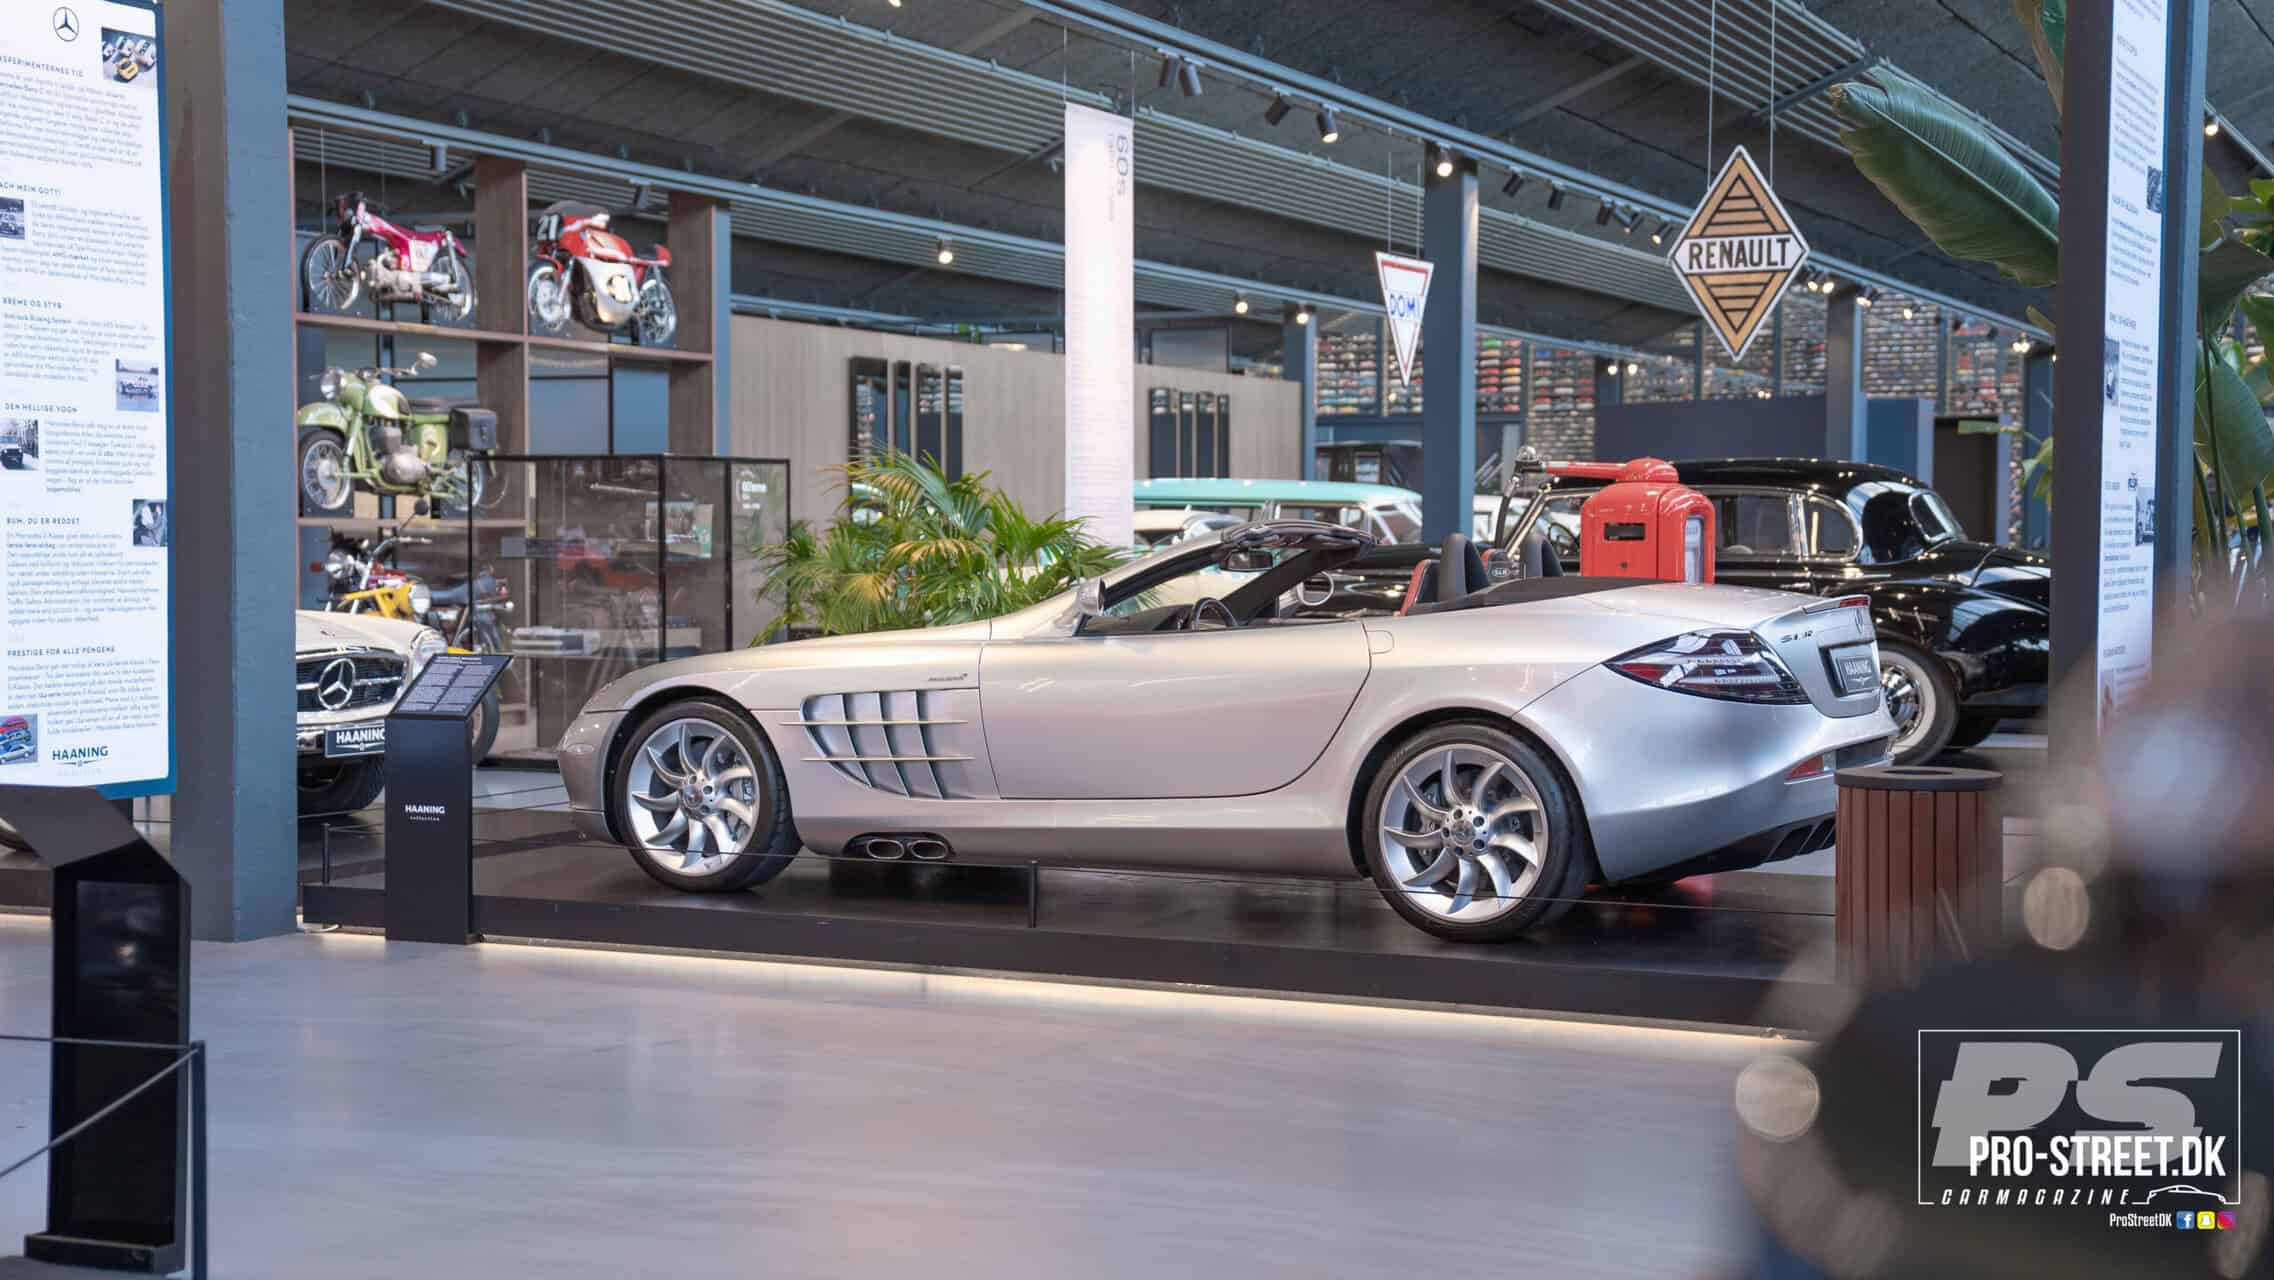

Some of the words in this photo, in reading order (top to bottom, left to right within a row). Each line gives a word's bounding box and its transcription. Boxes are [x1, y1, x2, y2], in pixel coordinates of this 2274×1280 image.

[536, 214, 559, 241] 21
[1688, 237, 1791, 270] RENAULT
[52, 745, 109, 761] HAANING
[405, 804, 446, 815] HAANING
